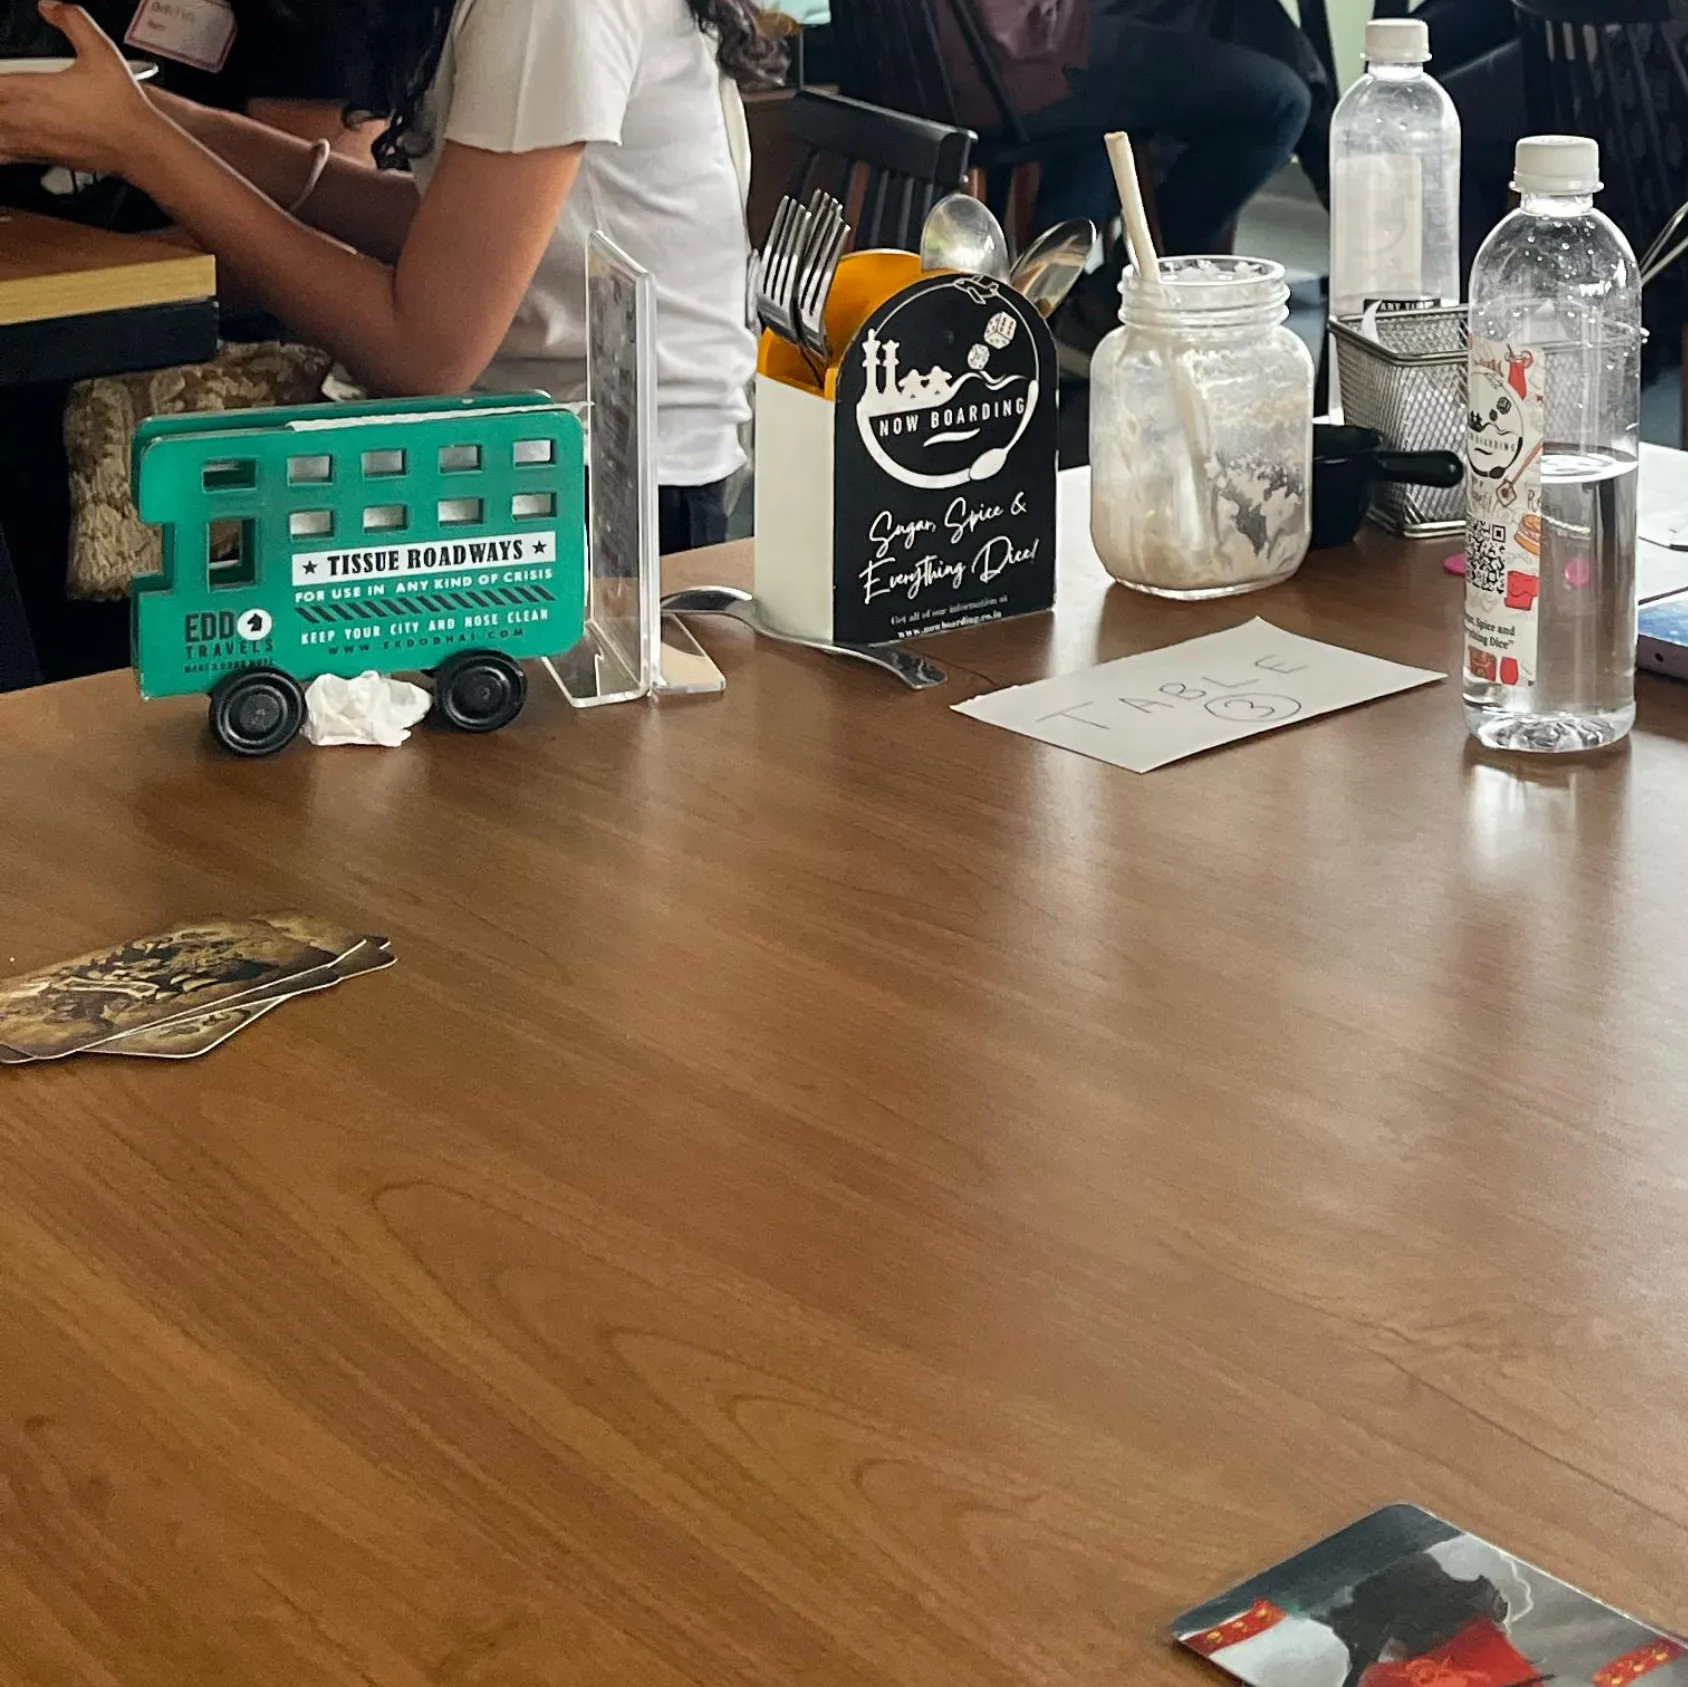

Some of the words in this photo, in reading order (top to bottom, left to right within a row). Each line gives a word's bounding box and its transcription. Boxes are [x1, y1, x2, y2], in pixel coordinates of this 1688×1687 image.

[878, 414, 920, 437] NOW
[930, 397, 1025, 429] BOARDING
[869, 510, 937, 559] Sugar,
[944, 496, 1004, 544] Spice
[1010, 491, 1027, 516] &
[327, 549, 400, 577] TISSUE
[407, 539, 524, 570] ROADWAYS
[858, 554, 967, 605] Everything
[970, 535, 1040, 584] Dice!
[294, 590, 325, 603] FOR
[331, 586, 361, 599] USE
[367, 583, 385, 596] IN
[395, 580, 429, 593] ANY
[434, 576, 473, 589] KIND
[478, 573, 498, 585] OF
[503, 568, 553, 582] CRISIS
[301, 629, 336, 645] KEEP
[345, 625, 381, 640] YOUR
[390, 621, 420, 636] CITY
[428, 618, 455, 631] AND
[464, 613, 498, 628] NOSE
[507, 608, 549, 623] CLEAN
[185, 638, 274, 660] TRAVELS
[1034, 653, 1310, 732] TABLE
